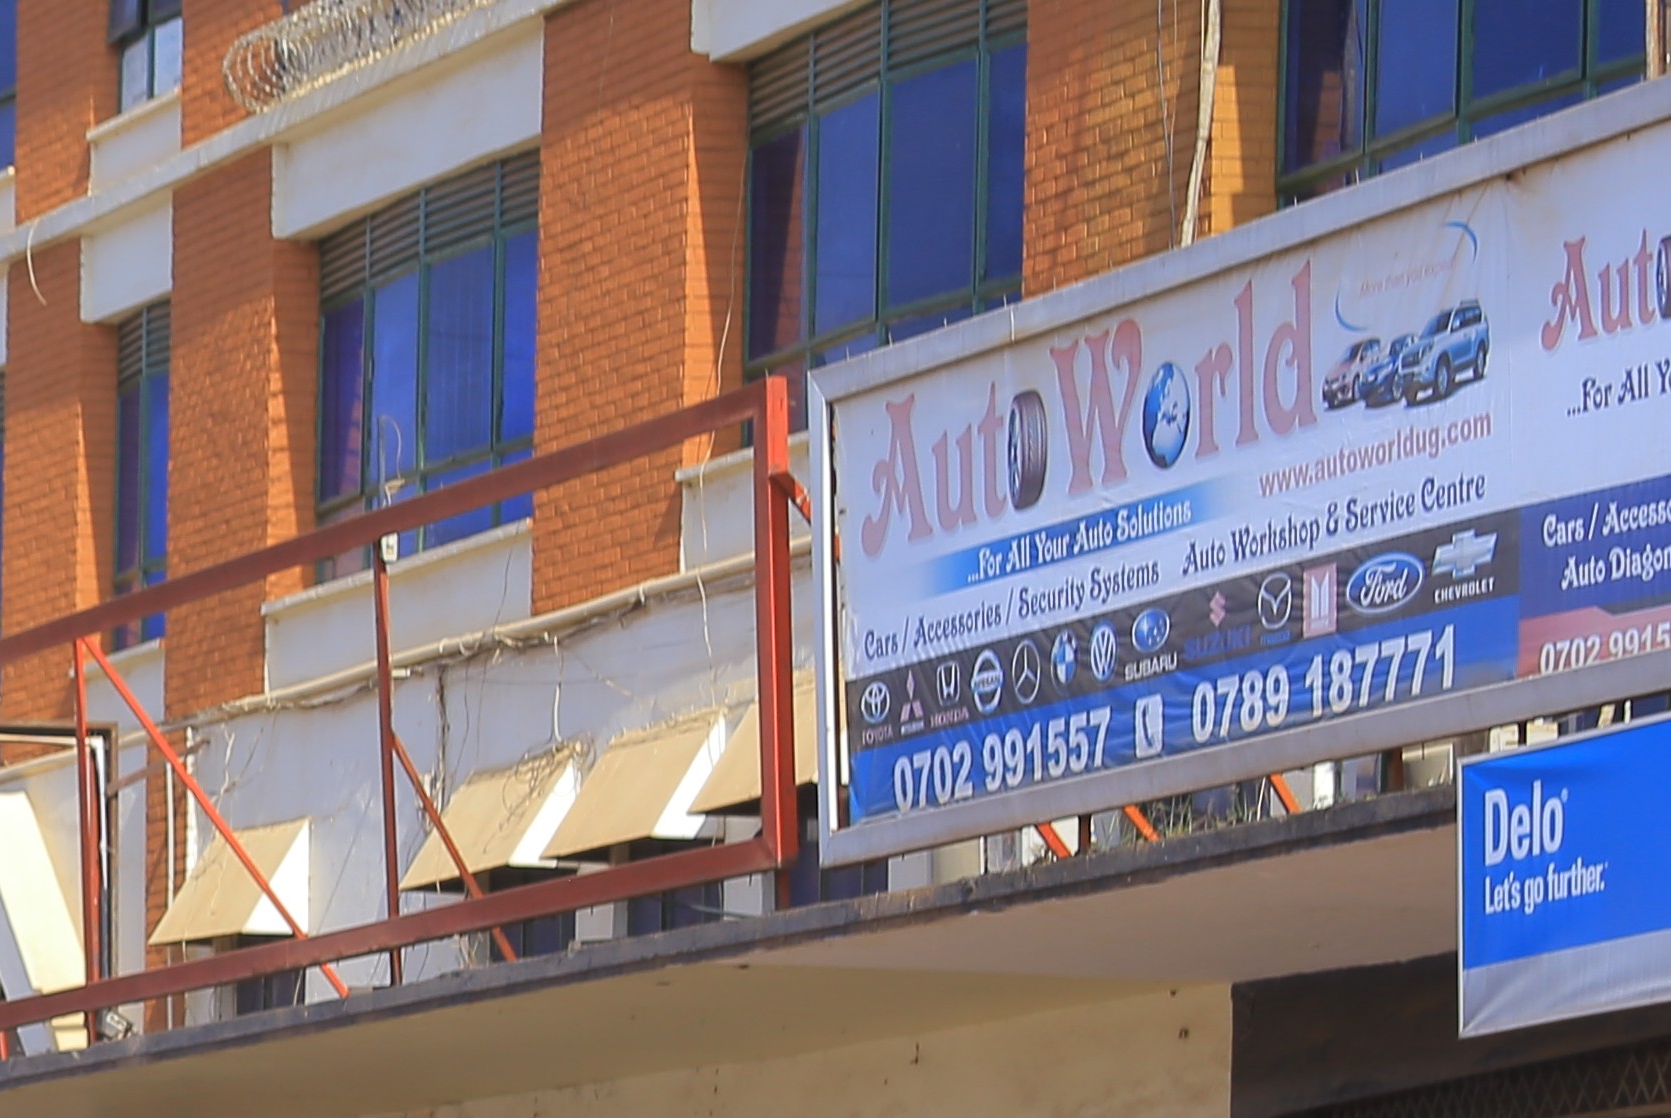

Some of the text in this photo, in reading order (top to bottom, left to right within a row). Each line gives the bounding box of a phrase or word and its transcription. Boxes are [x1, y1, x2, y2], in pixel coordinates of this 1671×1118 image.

[1617, 363, 1649, 406] All
[1259, 411, 1493, 498] www.autoworldug.com
[1005, 538, 1032, 570] All
[1034, 531, 1071, 565] Your
[1073, 520, 1114, 556] Auto
[1116, 498, 1192, 541] Solutions
[1181, 472, 1487, 577] Auto Workshop & Service Centre
[1542, 512, 1585, 548] Cars
[1359, 563, 1409, 607] Ford
[1434, 576, 1496, 605] CHEVROLET
[1560, 553, 1606, 591] Auto
[863, 629, 899, 660] Cars
[913, 603, 1003, 649] Accessories
[1018, 579, 1086, 620] Security
[1089, 559, 1161, 604] Systems
[1124, 651, 1178, 682] SUBARU
[1191, 623, 1455, 744] 0789 187771
[862, 724, 894, 745] TOYOTA
[930, 705, 970, 728] HONDA
[892, 704, 1113, 814] 0702 991557
[1484, 870, 1521, 915] Let's
[1524, 875, 1544, 915] go
